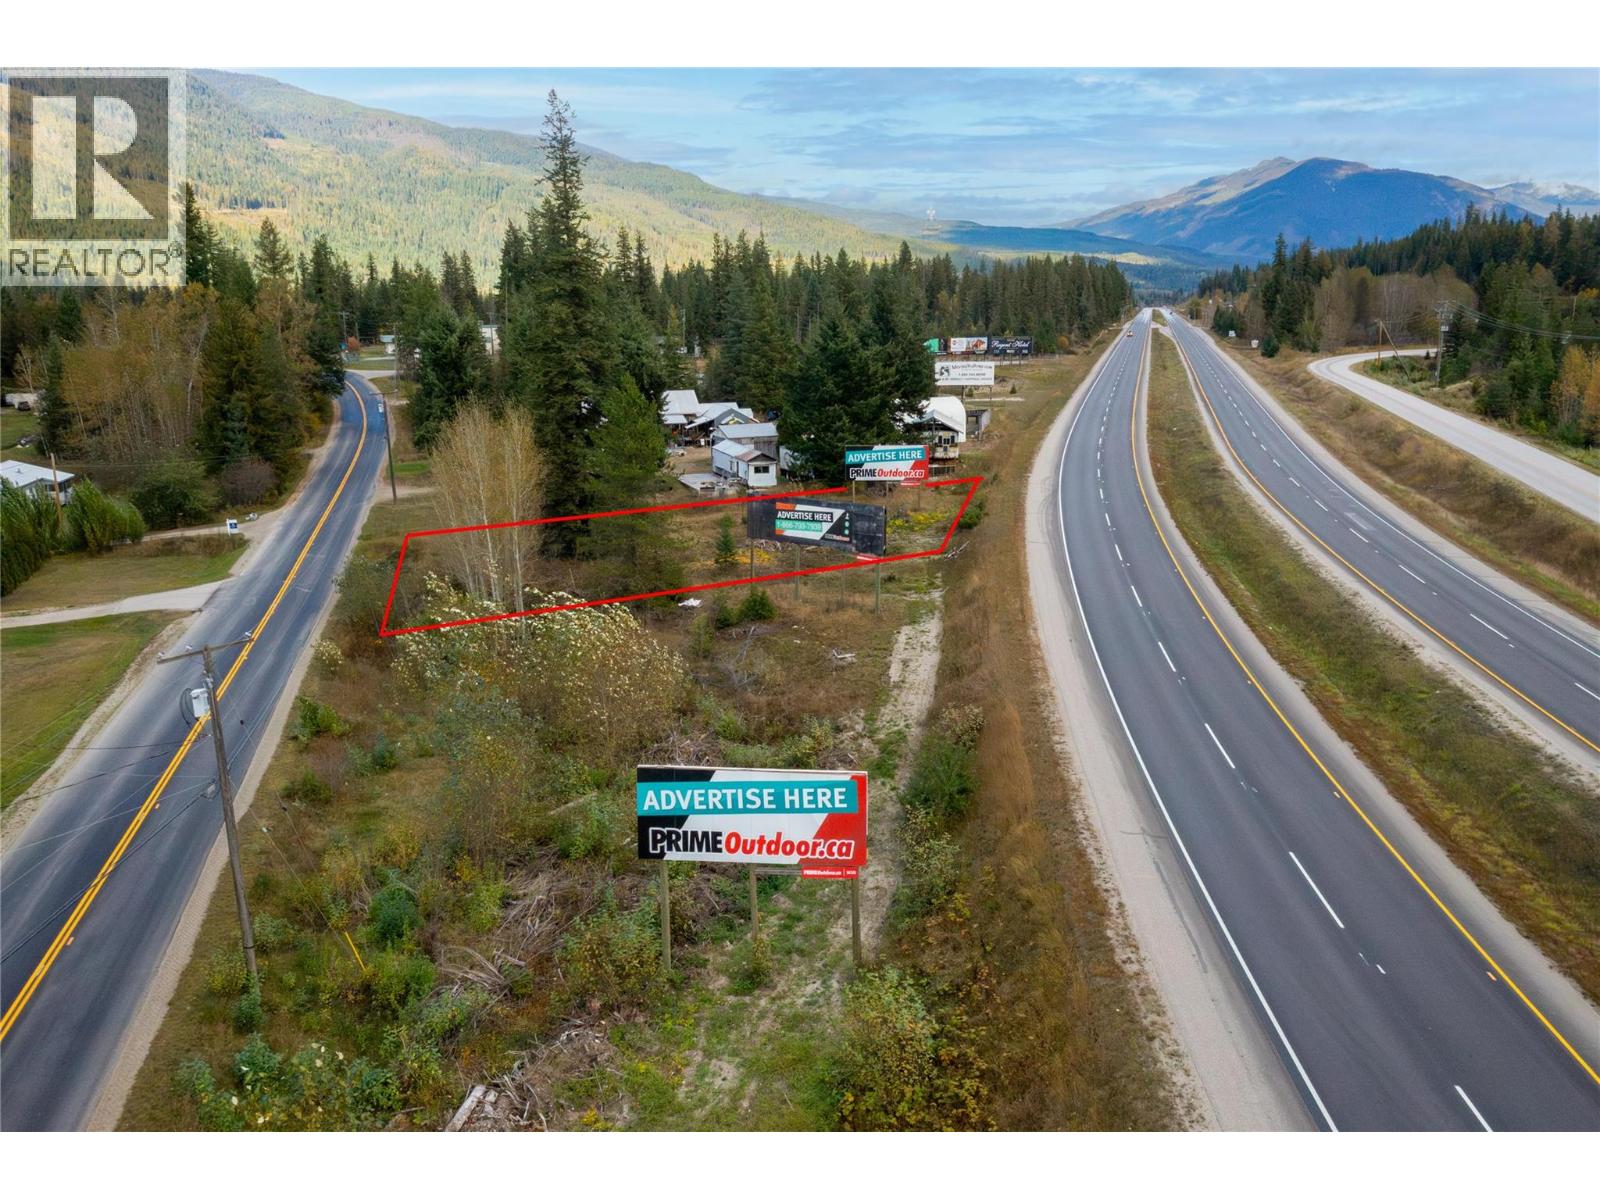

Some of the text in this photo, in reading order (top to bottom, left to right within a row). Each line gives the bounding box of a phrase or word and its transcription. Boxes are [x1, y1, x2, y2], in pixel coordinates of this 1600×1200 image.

[848, 450, 923, 463] ADVERTISE HERE
[777, 511, 832, 522] ADVERTISE HERE
[643, 787, 848, 810] ADVERTISE HERE
[649, 827, 855, 860] PRIMEOutdoor.ca
